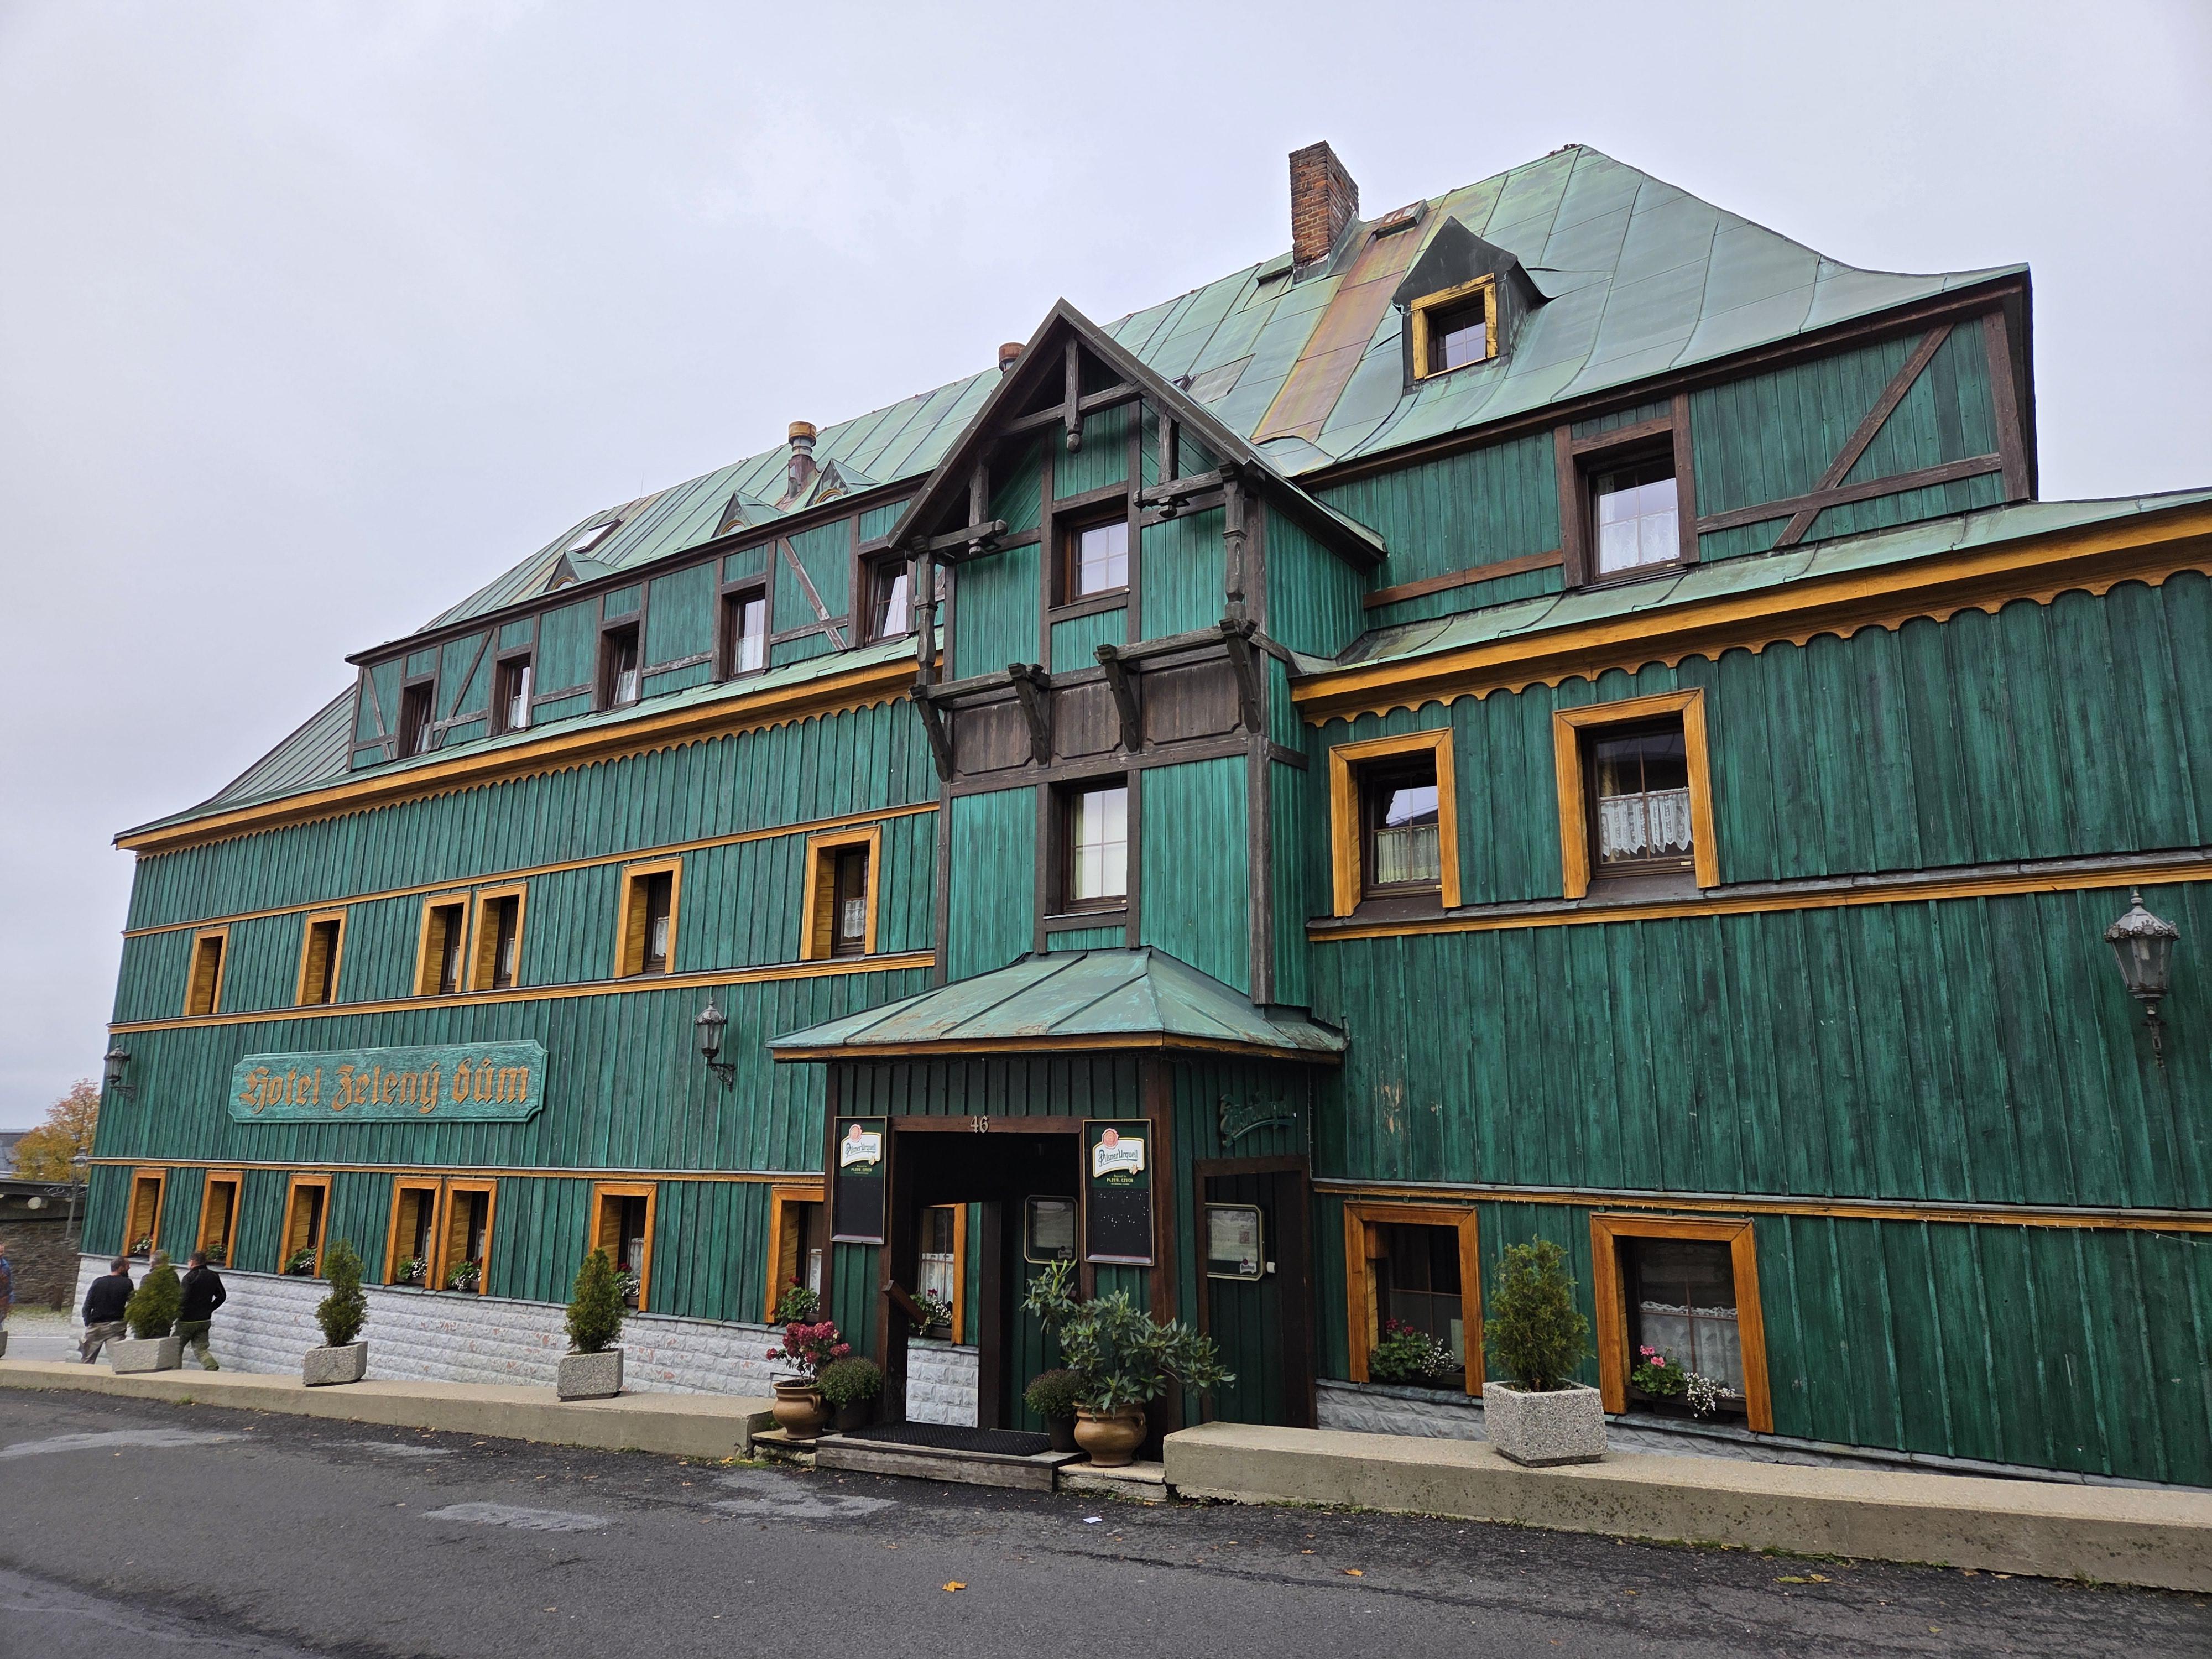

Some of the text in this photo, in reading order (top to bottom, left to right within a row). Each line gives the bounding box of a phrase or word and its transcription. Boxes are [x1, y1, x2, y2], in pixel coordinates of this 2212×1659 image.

[239, 1066, 322, 1114] Hotel
[331, 1061, 441, 1114] Zelený
[970, 1115, 988, 1133] 46
[1098, 1149, 1138, 1167] Pilsner Urquell
